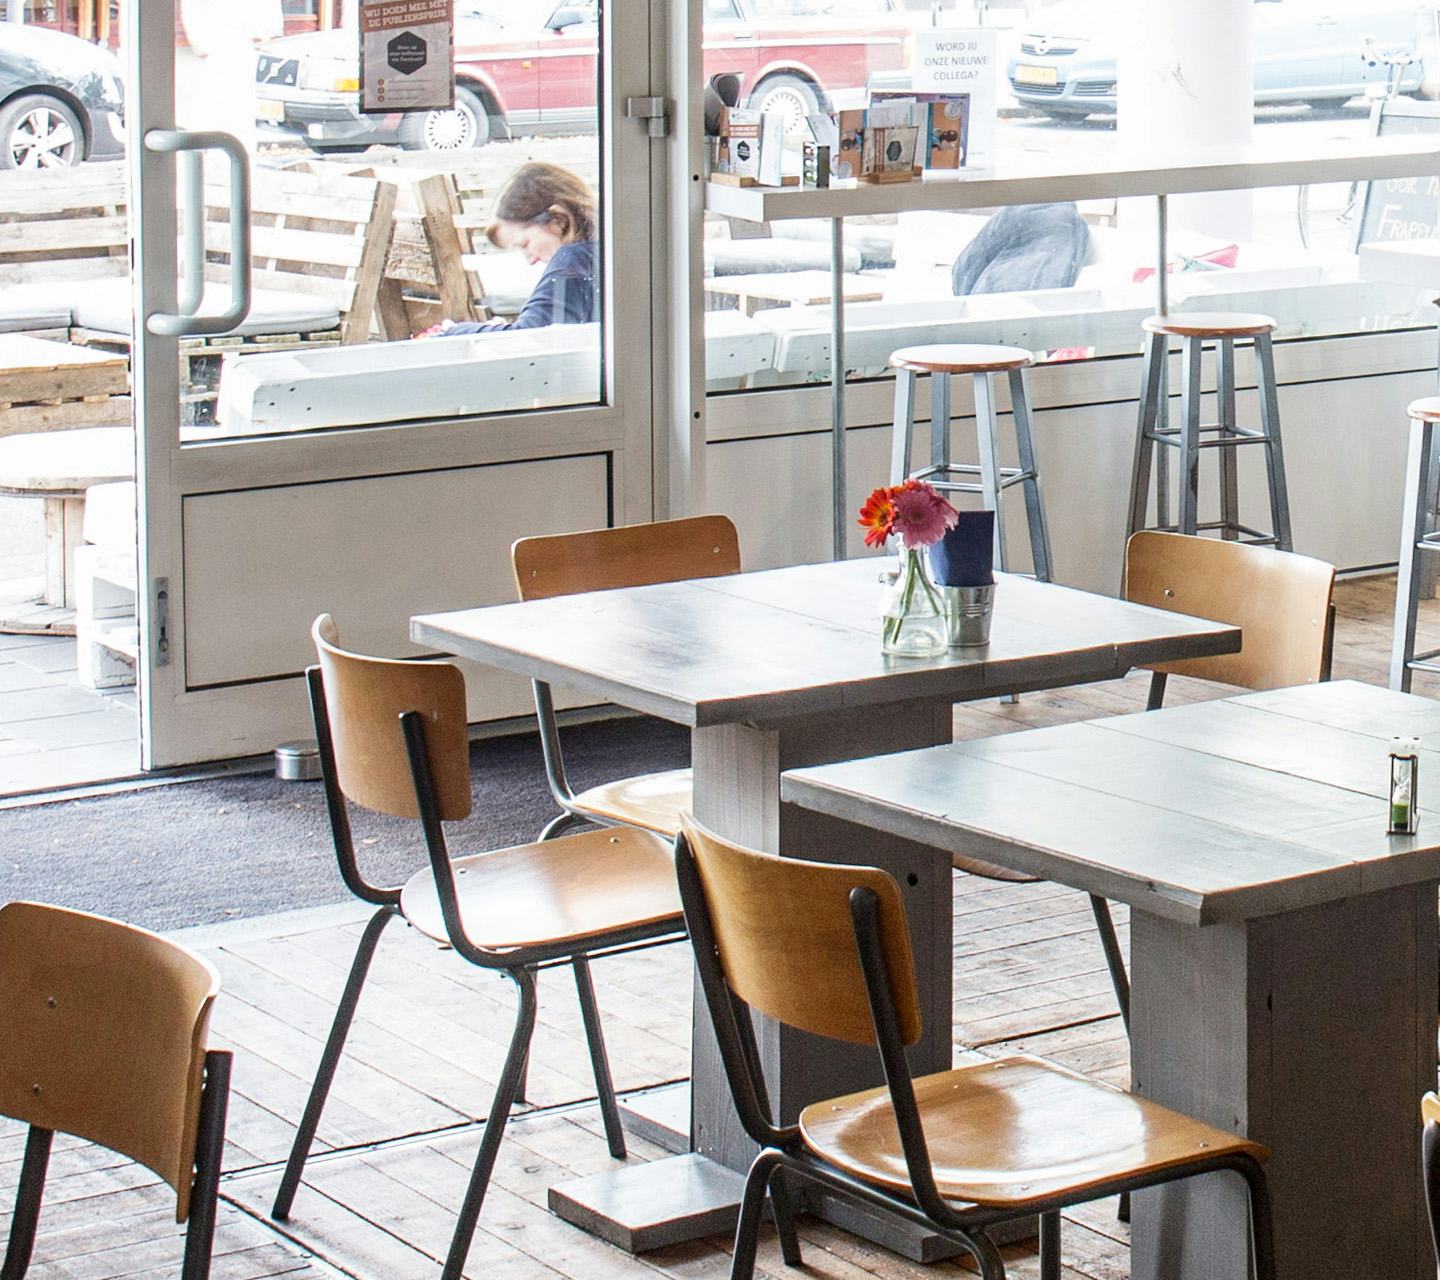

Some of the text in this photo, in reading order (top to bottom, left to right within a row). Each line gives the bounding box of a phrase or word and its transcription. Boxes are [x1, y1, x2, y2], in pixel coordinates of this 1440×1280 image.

[936, 42, 964, 52] WORD
[924, 55, 988, 66] ONZE NIEUWE
[933, 70, 978, 81] COLLEGA?
